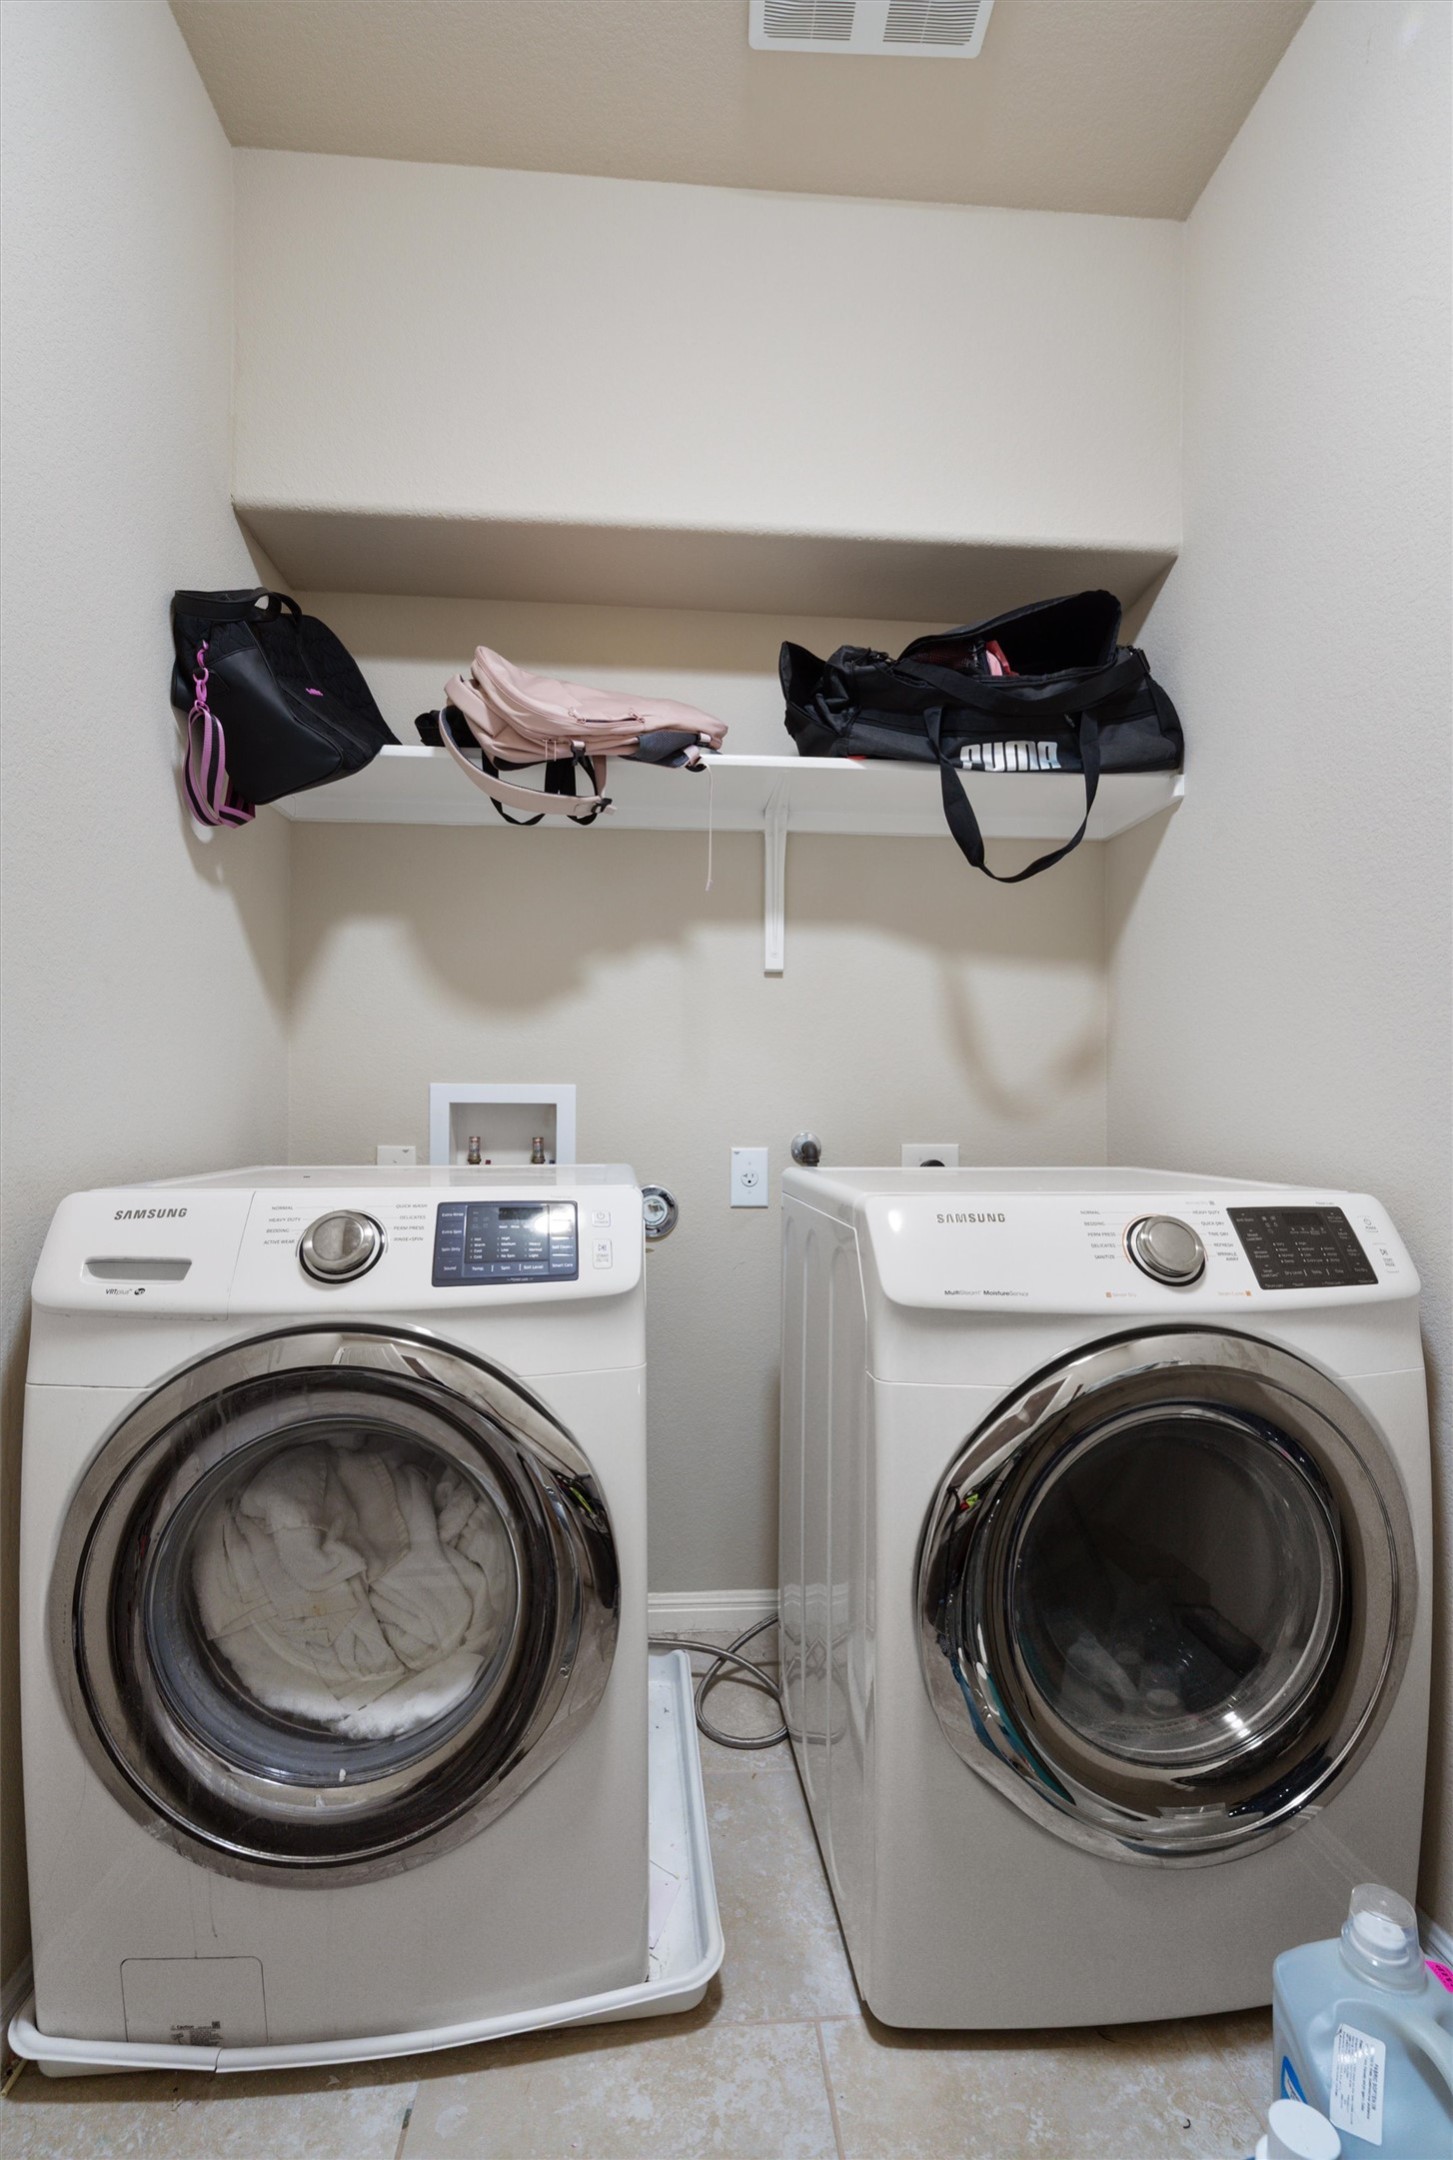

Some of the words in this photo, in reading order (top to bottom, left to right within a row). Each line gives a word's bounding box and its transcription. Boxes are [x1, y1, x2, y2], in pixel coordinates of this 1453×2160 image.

[959, 740, 1062, 772] PUMA
[114, 1207, 188, 1221] SAMSUNG
[936, 1212, 1006, 1224] SAMSUNG
